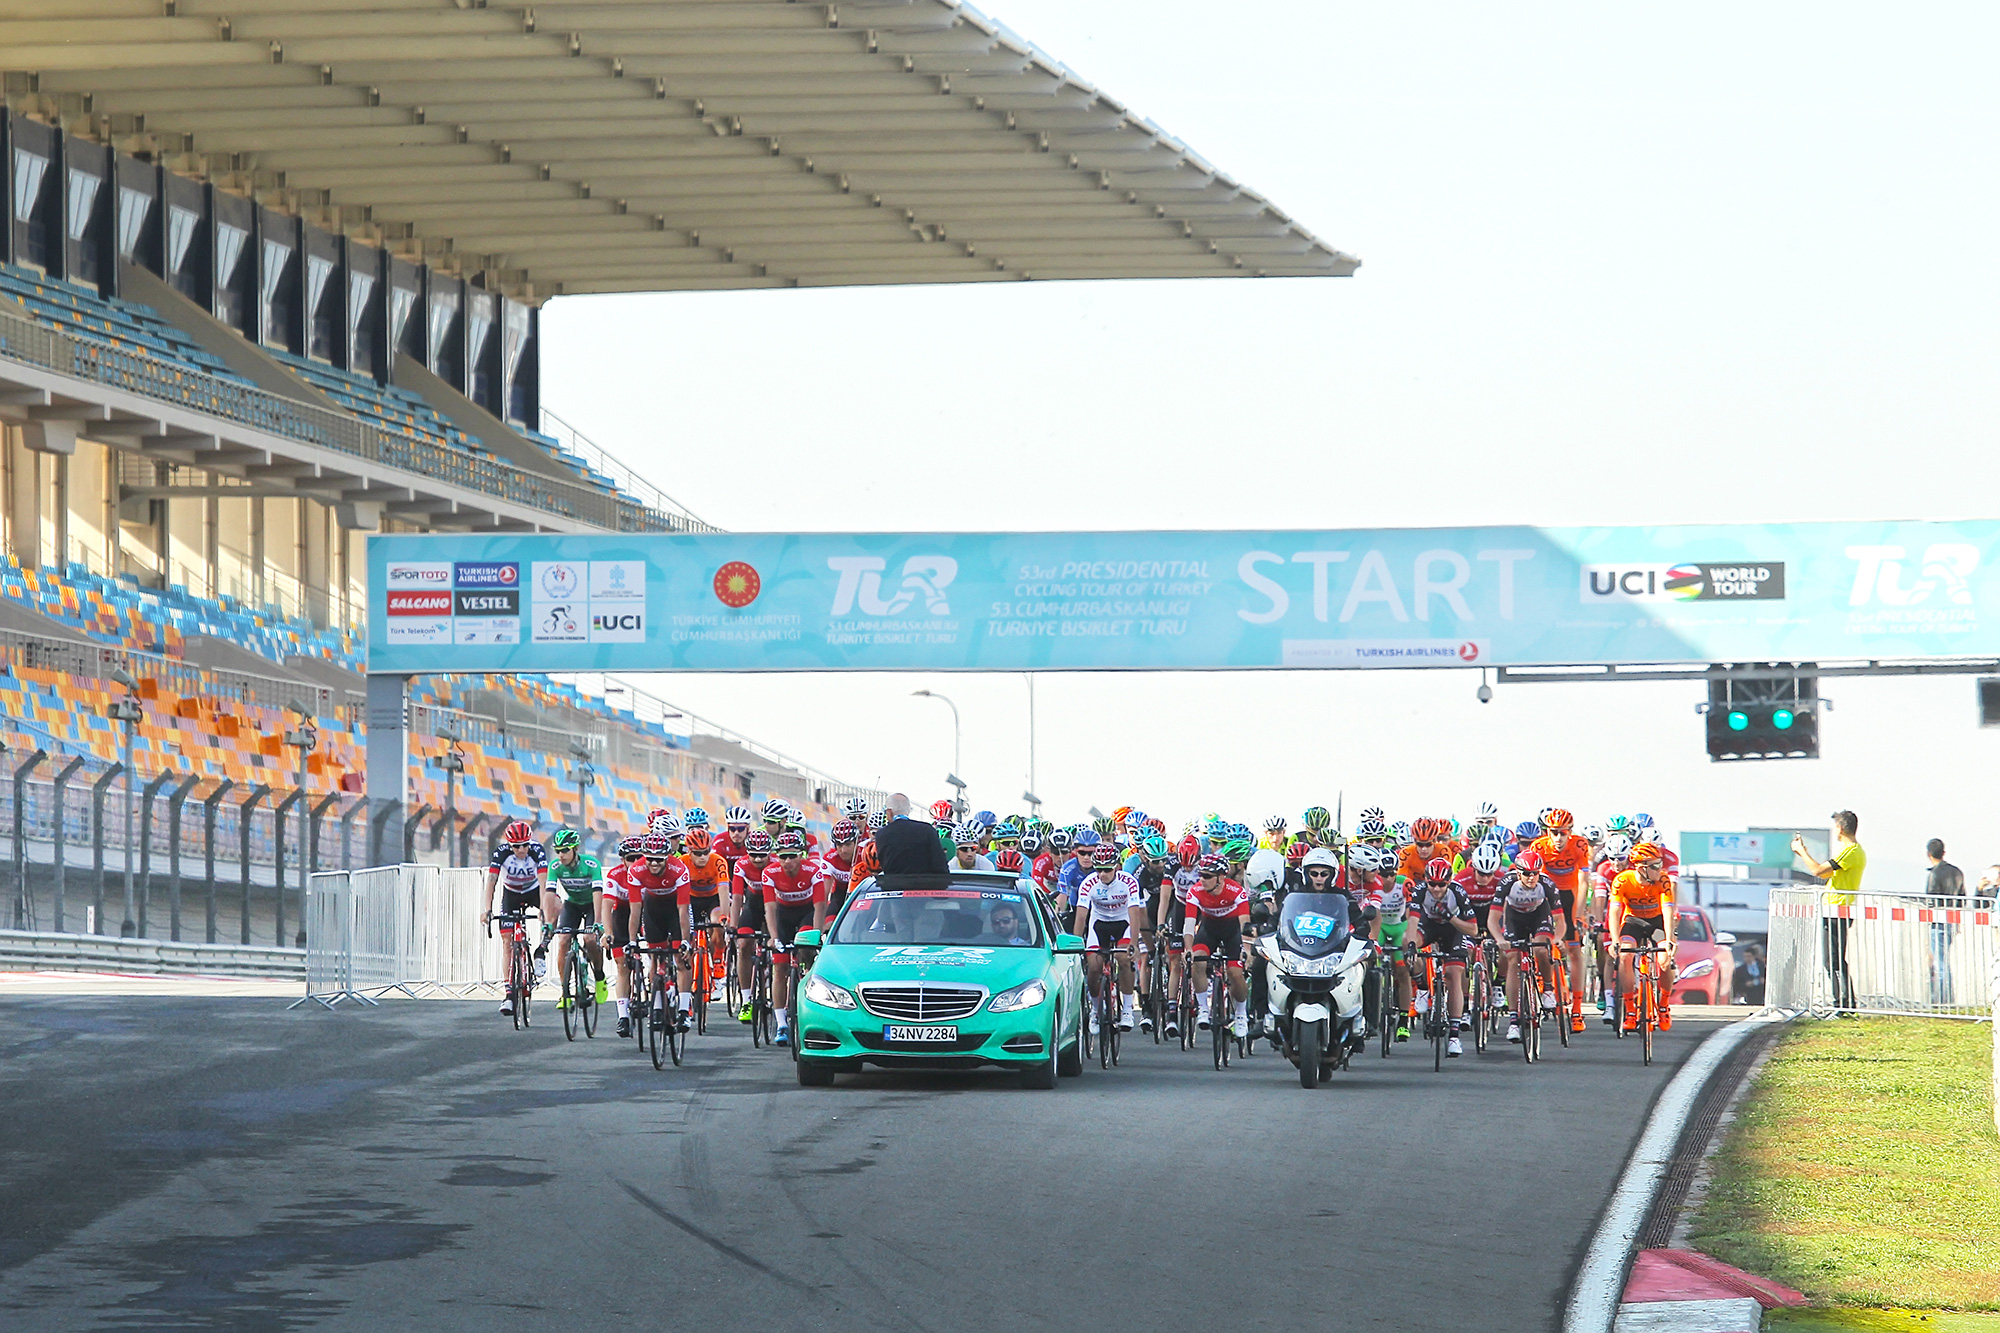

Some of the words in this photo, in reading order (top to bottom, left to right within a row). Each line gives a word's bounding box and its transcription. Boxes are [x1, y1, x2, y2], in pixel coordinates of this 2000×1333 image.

[458, 567, 499, 575] TURKISH
[1018, 565, 1058, 580] 53rd
[1060, 560, 1210, 580] PRESIDENTIAL
[1708, 566, 1771, 582] WORLD
[458, 575, 498, 583] AIRLINES
[1237, 549, 1536, 624] START
[1588, 570, 1656, 596] UCI
[1014, 582, 1077, 597] CYCLING
[1080, 582, 1123, 597] TOUR
[1125, 582, 1148, 596] OF
[1151, 581, 1213, 596] TURKEY
[1712, 581, 1758, 596] TOUR
[390, 597, 449, 609] SALCANO
[461, 596, 511, 610] VESTEL
[602, 614, 641, 631] UCI
[1138, 619, 1187, 636] TURU
[1355, 648, 1405, 658] TURKISH
[1406, 647, 1457, 657] AIRLINES
[715, 858, 727, 879] CCC
[1545, 858, 1575, 868] CCC
[508, 867, 535, 876] UAE
[851, 865, 867, 882] CCC
[1117, 873, 1138, 897] VESTEL
[1500, 875, 1513, 886] UAE
[1612, 875, 1627, 896] CCC
[1658, 874, 1672, 896] CCC
[856, 900, 866, 909] F
[1303, 937, 1315, 945] 03
